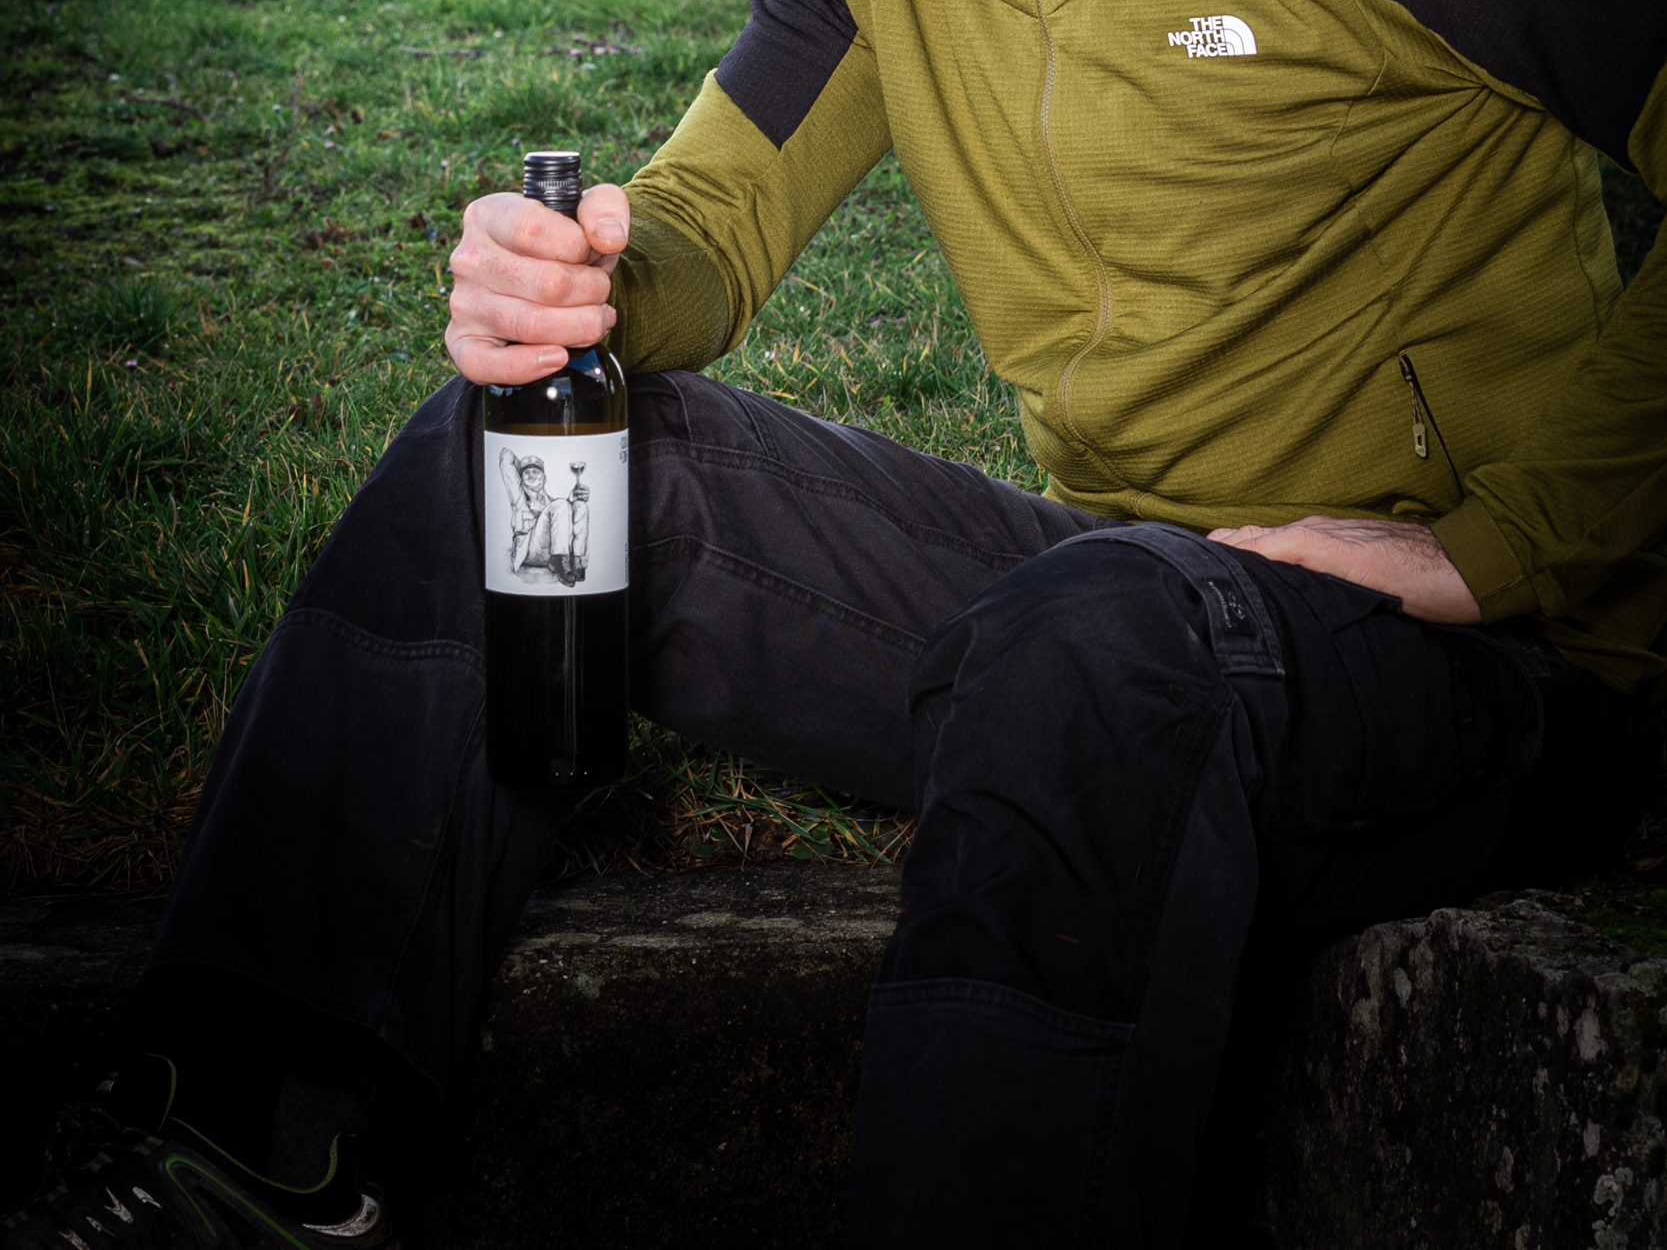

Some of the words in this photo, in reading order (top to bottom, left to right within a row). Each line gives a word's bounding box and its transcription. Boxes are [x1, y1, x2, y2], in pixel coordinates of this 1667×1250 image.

[1189, 16, 1222, 31] THE
[1168, 29, 1225, 46] NORTH
[1187, 42, 1228, 57] FACE
